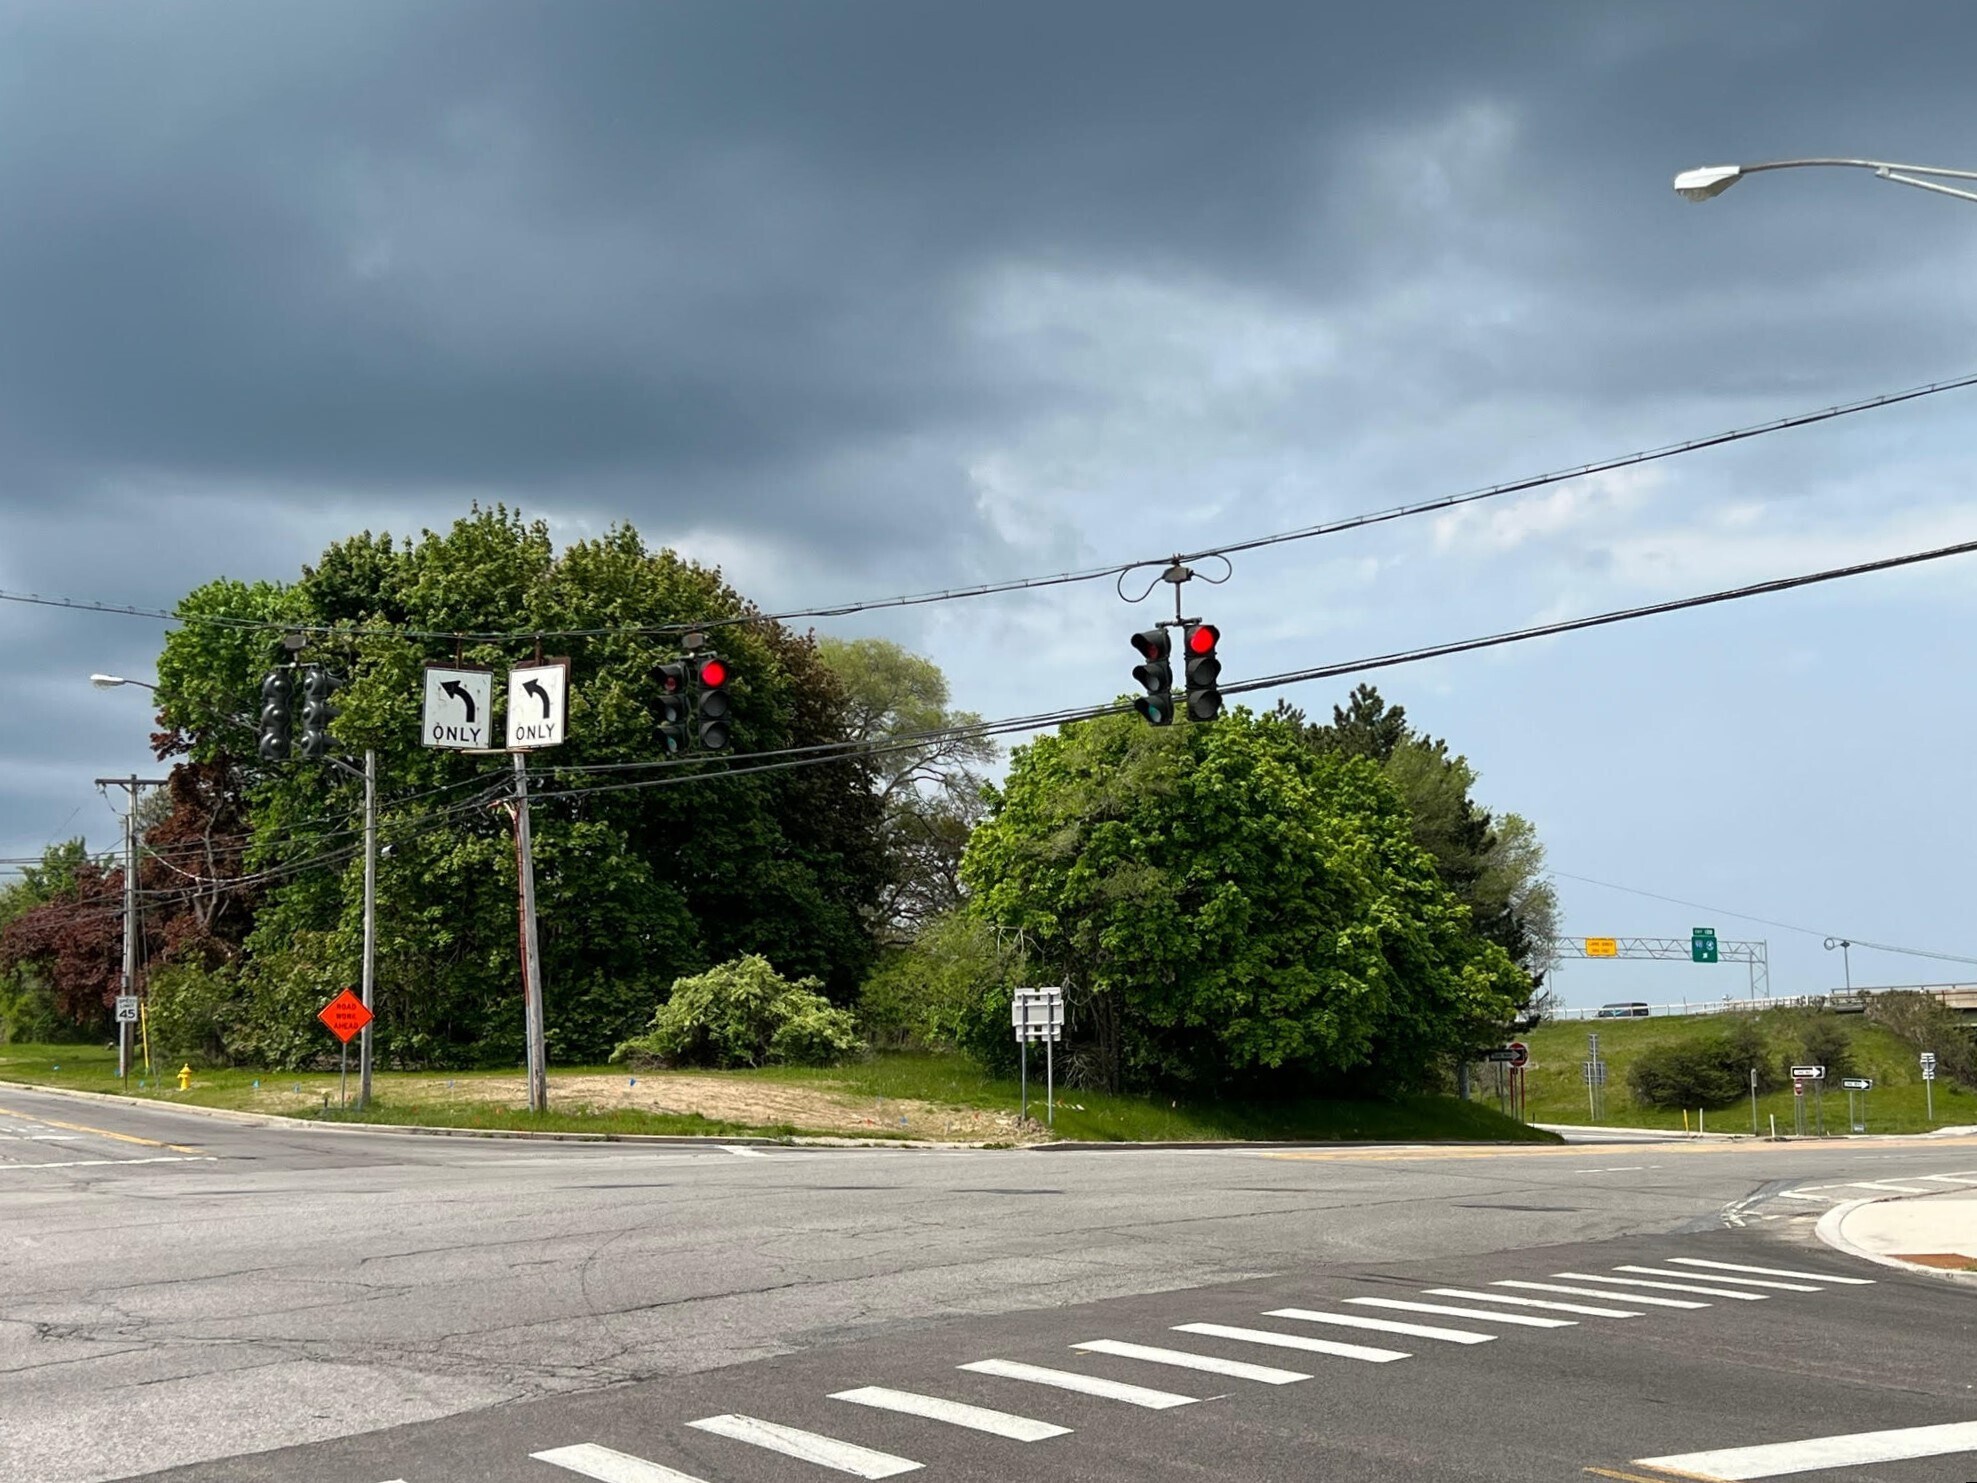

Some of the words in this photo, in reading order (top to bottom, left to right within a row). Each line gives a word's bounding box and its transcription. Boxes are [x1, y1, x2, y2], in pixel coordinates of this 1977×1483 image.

[432, 725, 481, 742] ONLY
[516, 723, 555, 741] ONLY
[119, 1009, 135, 1019] 45
[333, 1022, 359, 1030] AHEAD
